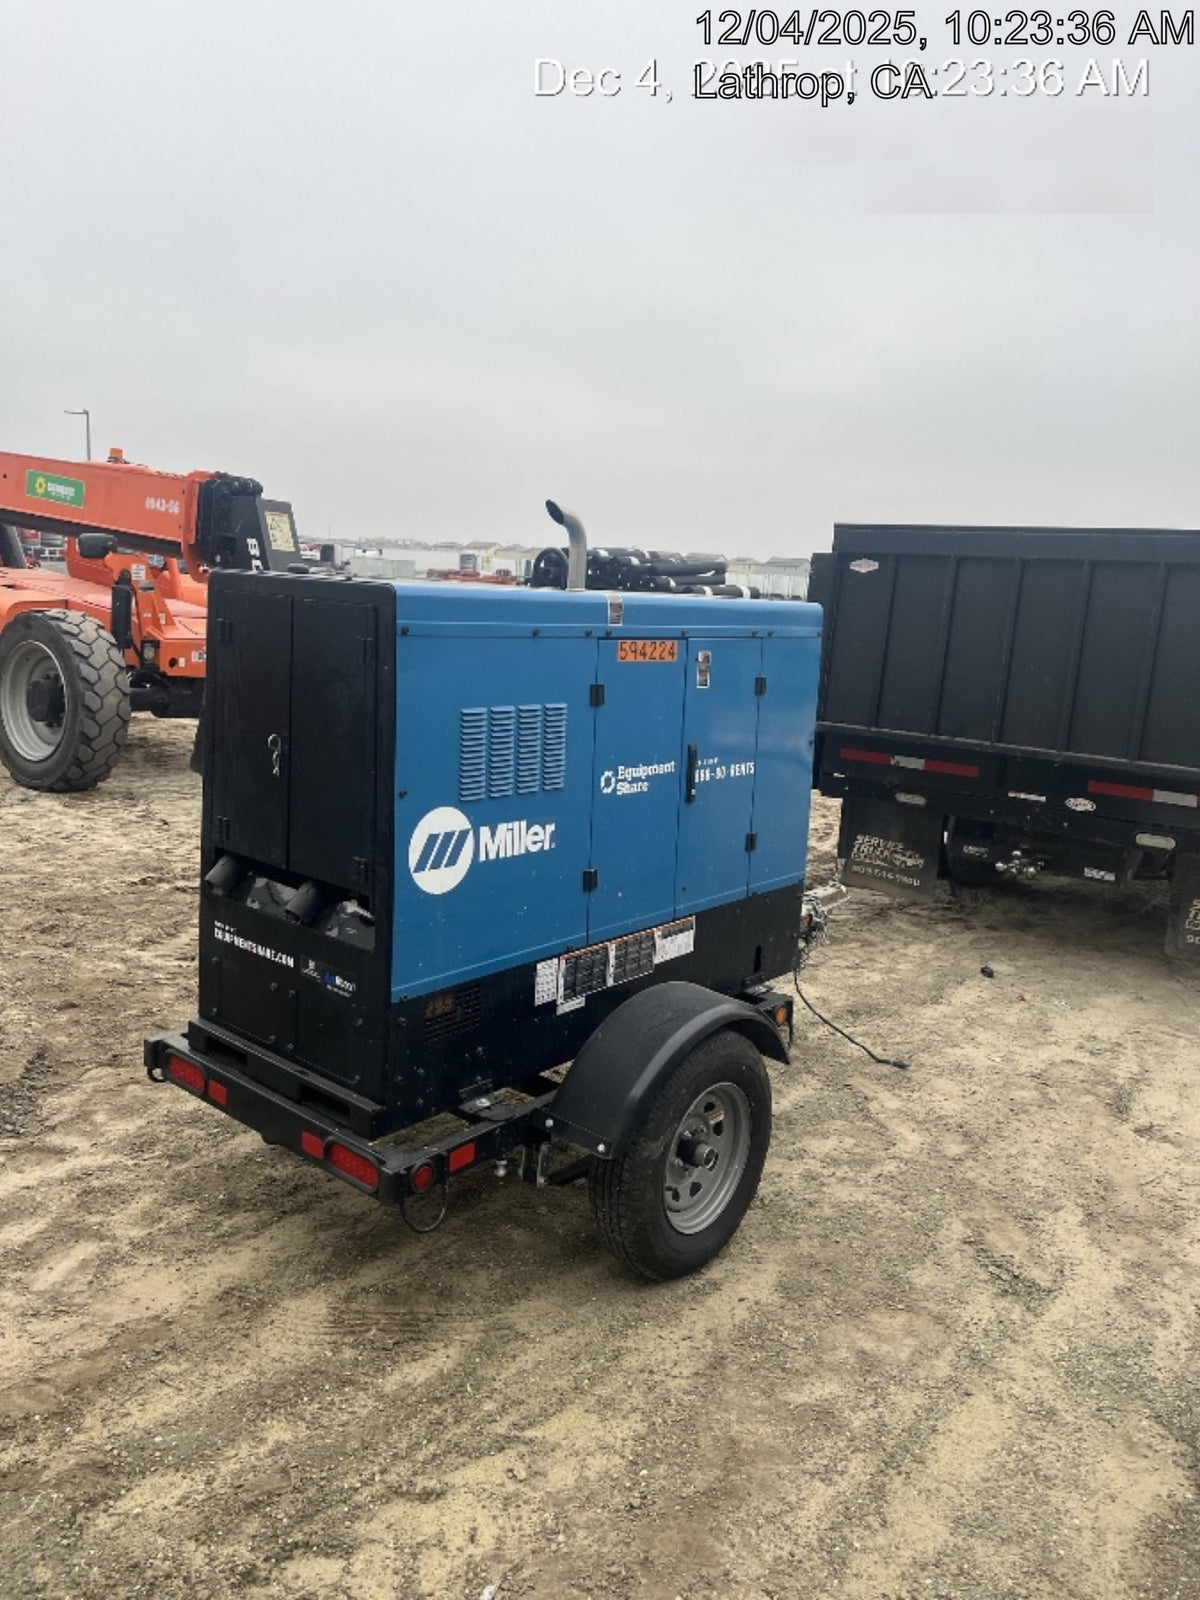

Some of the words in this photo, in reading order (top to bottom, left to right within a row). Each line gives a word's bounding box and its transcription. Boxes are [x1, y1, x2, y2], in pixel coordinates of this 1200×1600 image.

[619, 641, 676, 660] 594224
[617, 761, 677, 781] Equipment
[616, 781, 649, 796] Share
[478, 819, 556, 863] Miller
